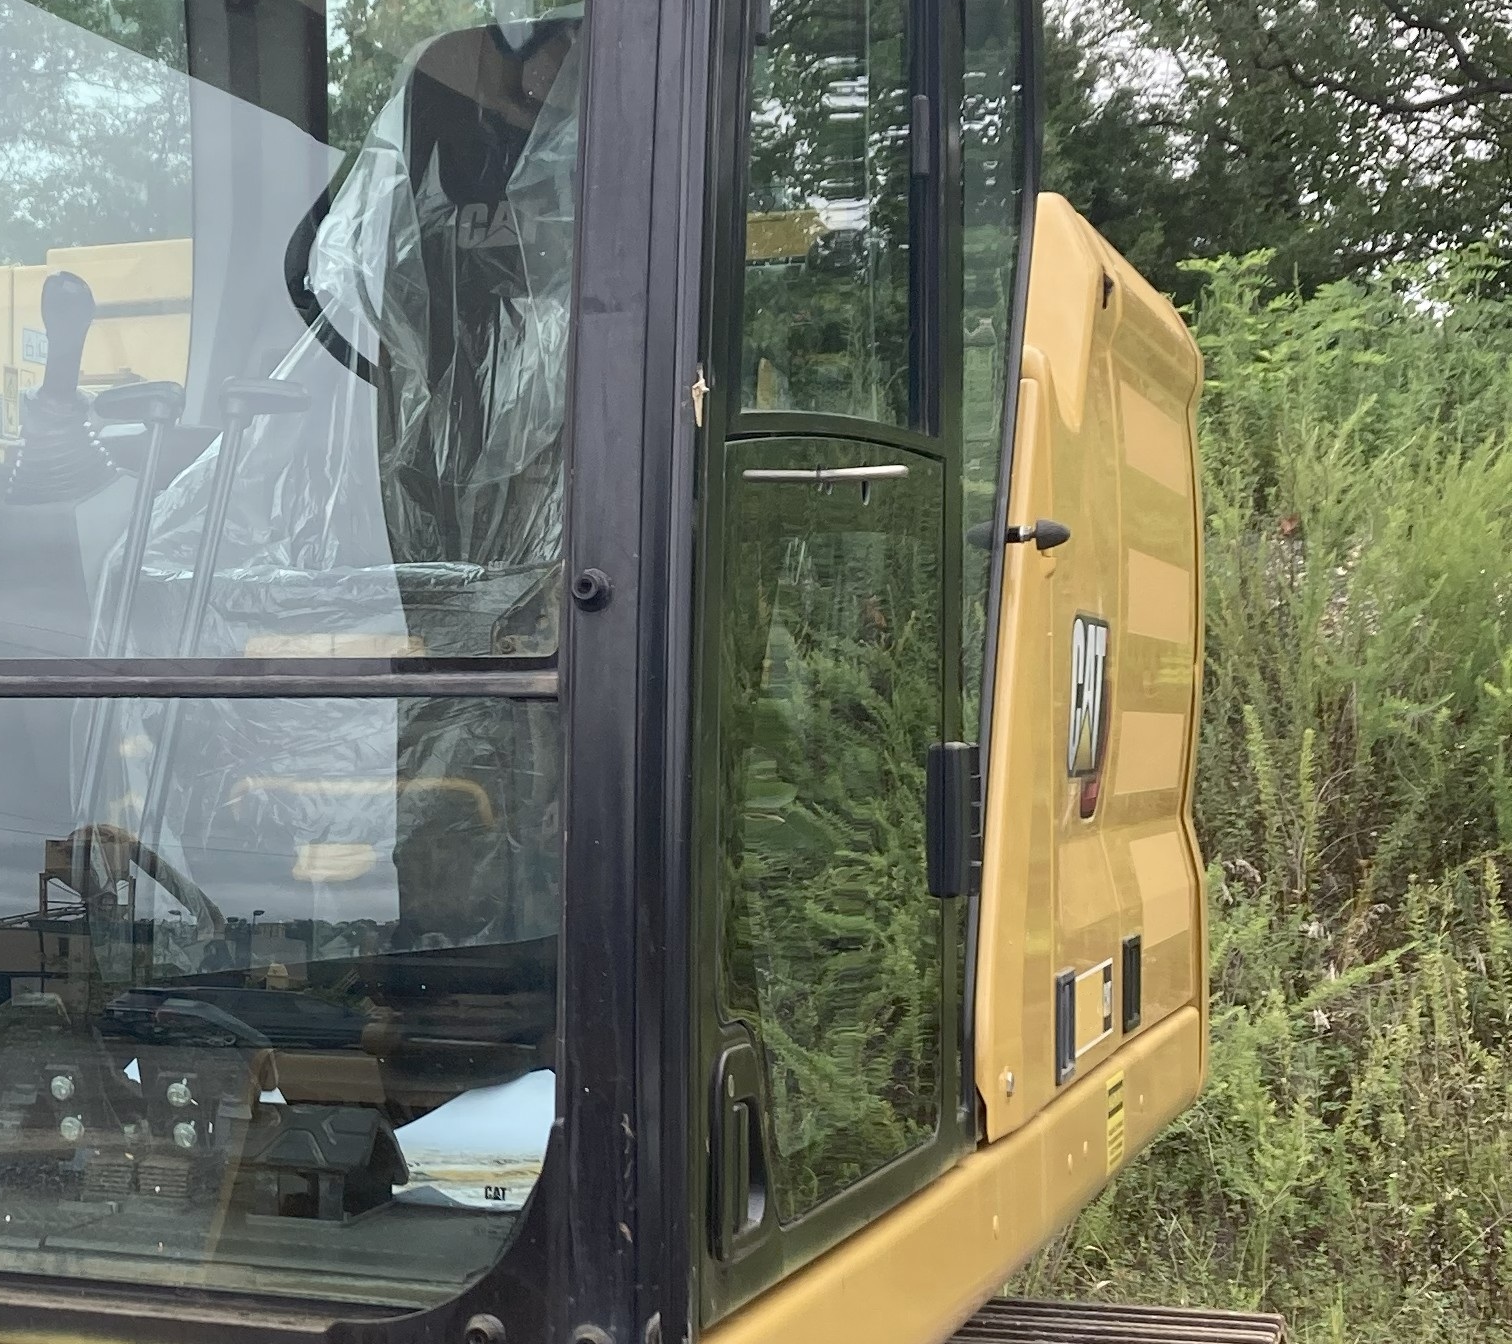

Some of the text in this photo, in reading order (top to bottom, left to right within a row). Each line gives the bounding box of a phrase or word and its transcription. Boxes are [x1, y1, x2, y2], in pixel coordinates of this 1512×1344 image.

[456, 197, 552, 249] CAT
[1067, 617, 1107, 771] CAT
[484, 1185, 507, 1201] CAT
